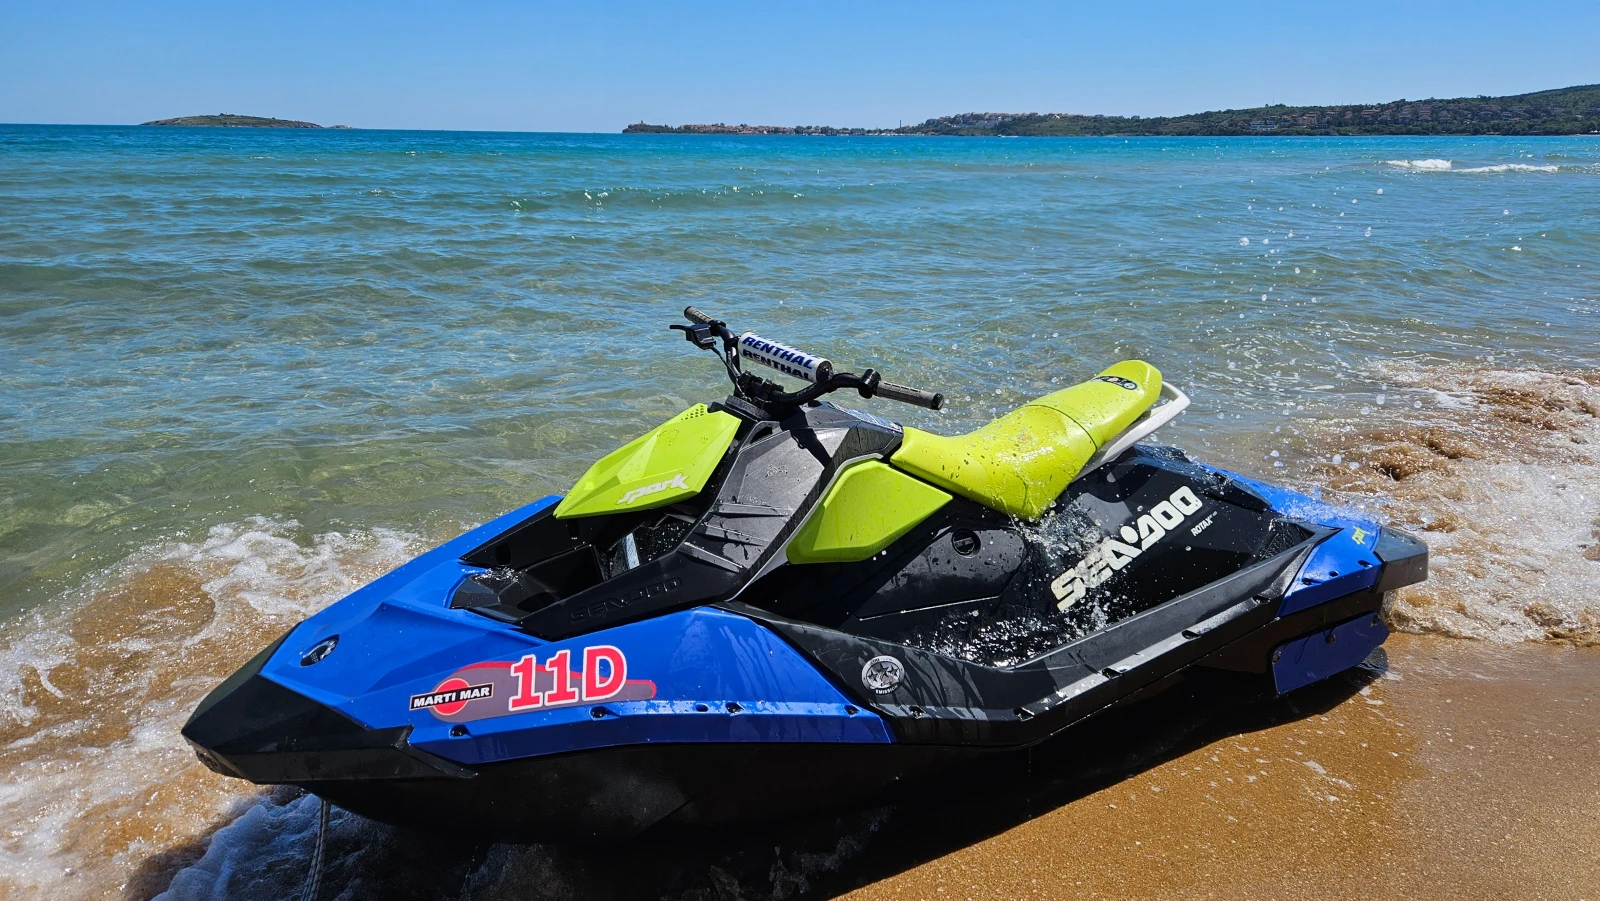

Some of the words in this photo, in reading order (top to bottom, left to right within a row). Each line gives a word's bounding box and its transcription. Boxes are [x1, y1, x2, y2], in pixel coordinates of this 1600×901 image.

[741, 336, 814, 369] RENTHAL
[1190, 516, 1213, 537] ROTAX
[509, 645, 628, 712] 11D
[413, 692, 456, 708] MARTI
[459, 687, 490, 699] MAR
